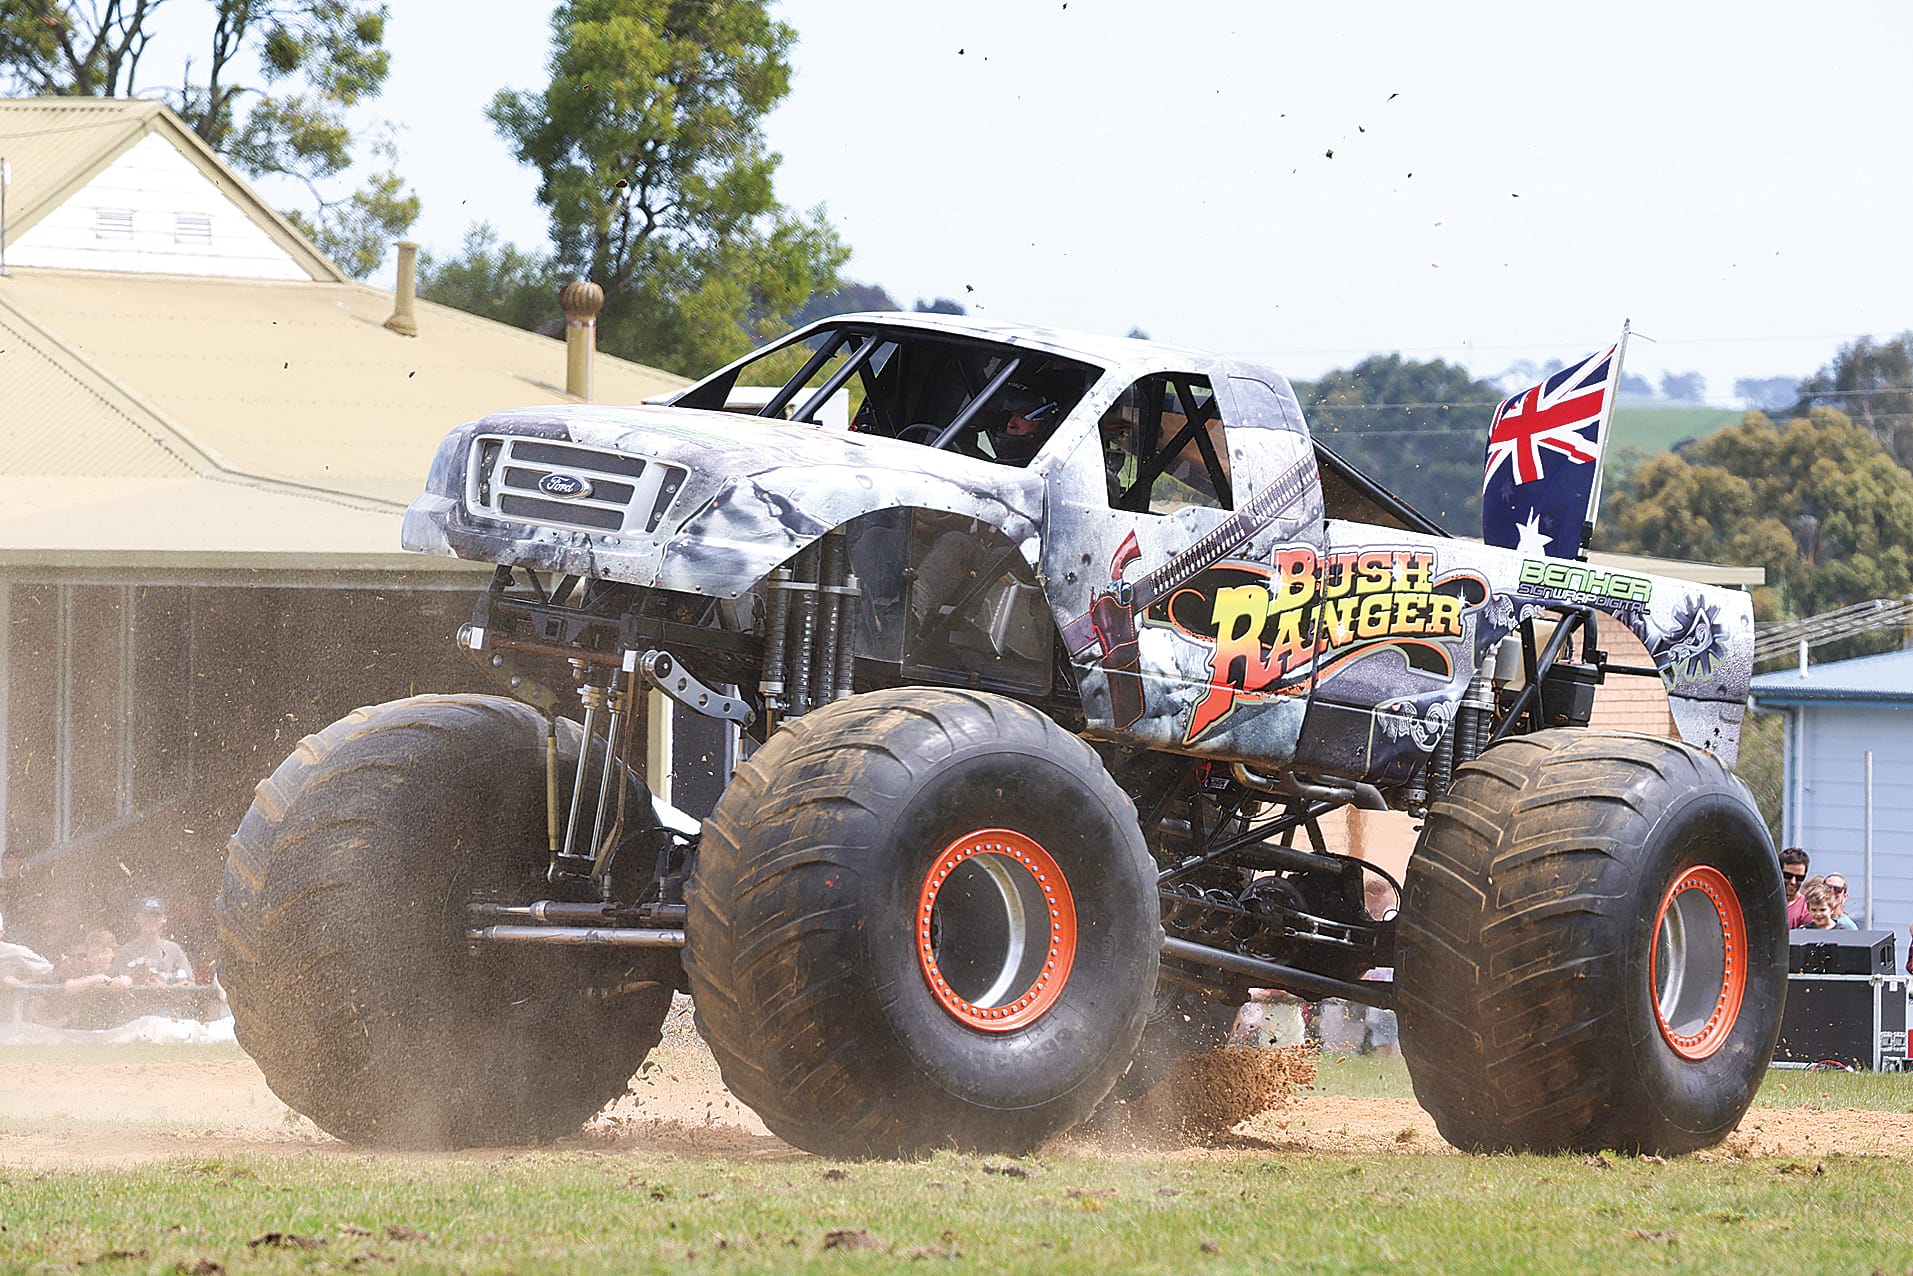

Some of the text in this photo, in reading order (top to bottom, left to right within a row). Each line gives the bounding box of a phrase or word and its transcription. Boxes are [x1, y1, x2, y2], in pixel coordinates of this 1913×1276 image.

[546, 476, 576, 493] Ford
[1267, 548, 1436, 616] BUSH
[1519, 559, 1653, 603] BENHER
[1187, 586, 1464, 741] RANGER
